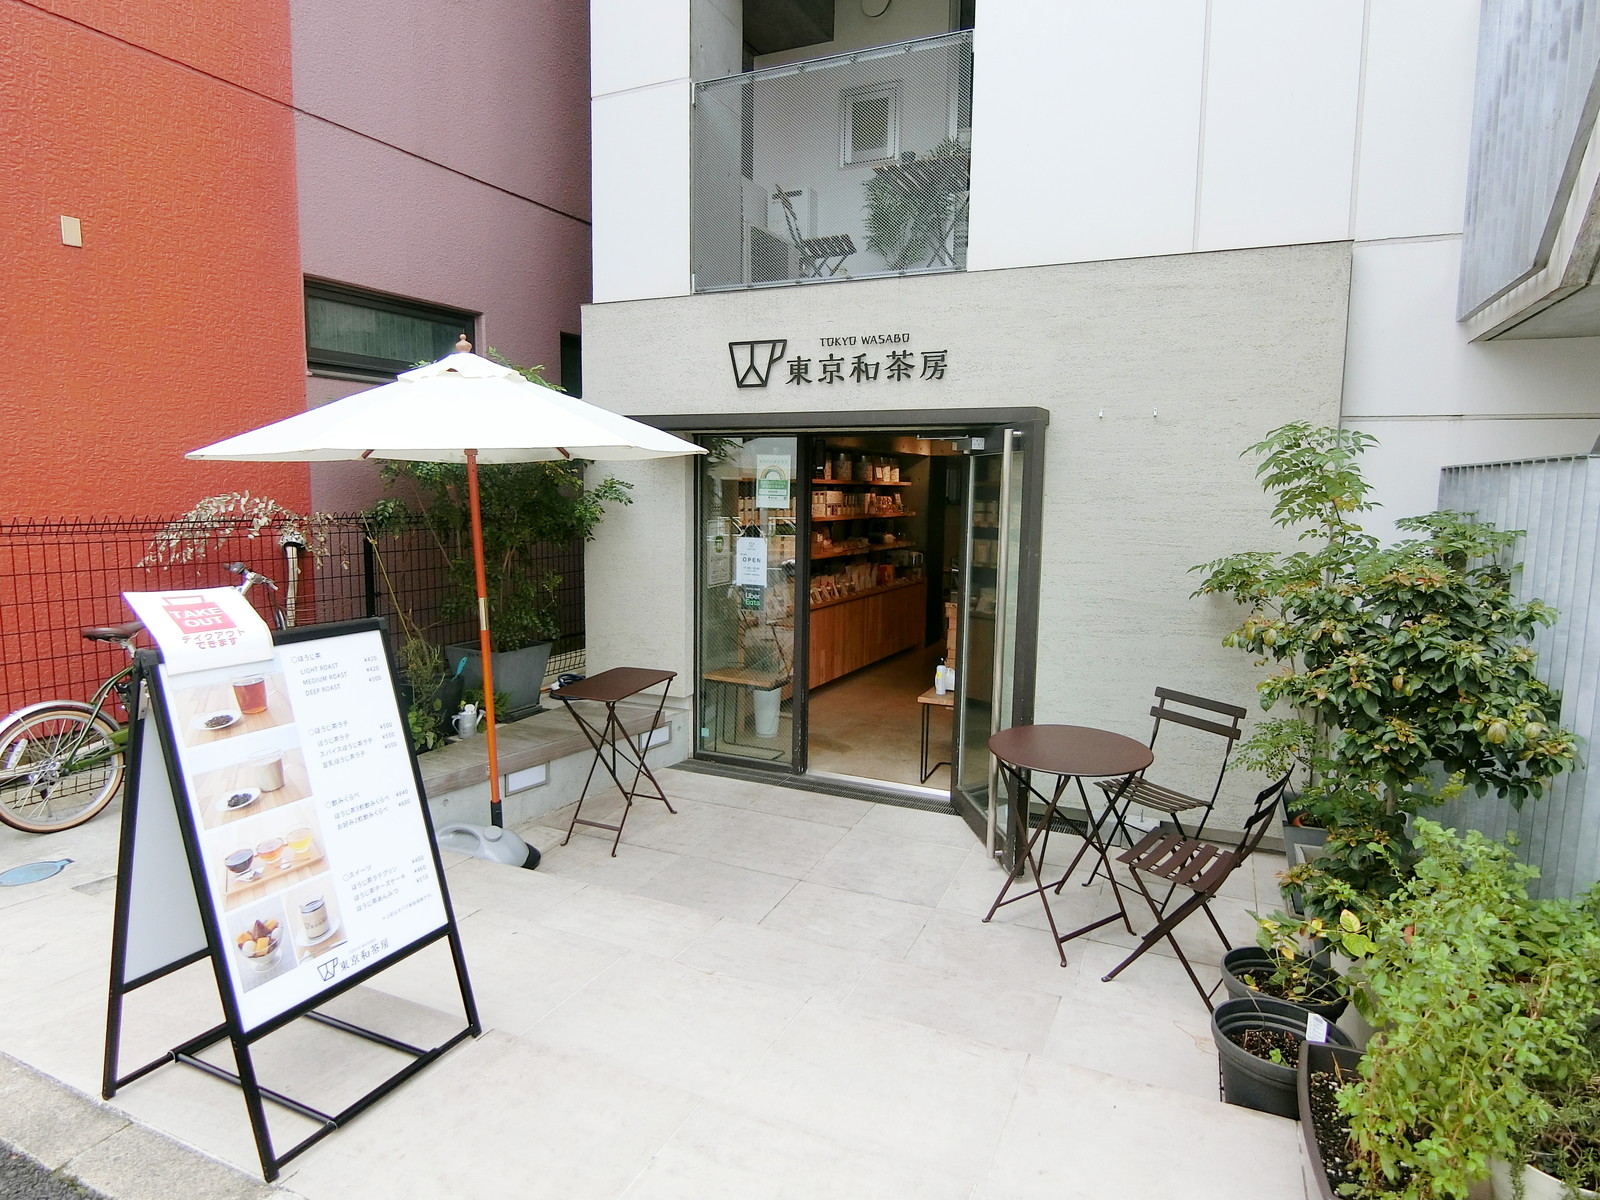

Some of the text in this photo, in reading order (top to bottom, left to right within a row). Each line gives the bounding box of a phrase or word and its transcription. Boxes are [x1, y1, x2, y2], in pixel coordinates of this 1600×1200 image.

[820, 333, 910, 347] TOKYO WASABO
[786, 349, 948, 386] 東京和茶房
[169, 607, 224, 619] TAKE
[184, 616, 223, 628] OUT
[182, 628, 246, 643] テイクアウト
[196, 637, 238, 649] できます
[300, 666, 318, 675] LIGHT
[320, 662, 338, 671] ROAST
[302, 676, 327, 685] MEDIUM
[329, 672, 347, 680] ROAST
[305, 688, 320, 696] DEEP
[322, 684, 340, 692] ROAST
[340, 938, 389, 972] 東京和茶房
